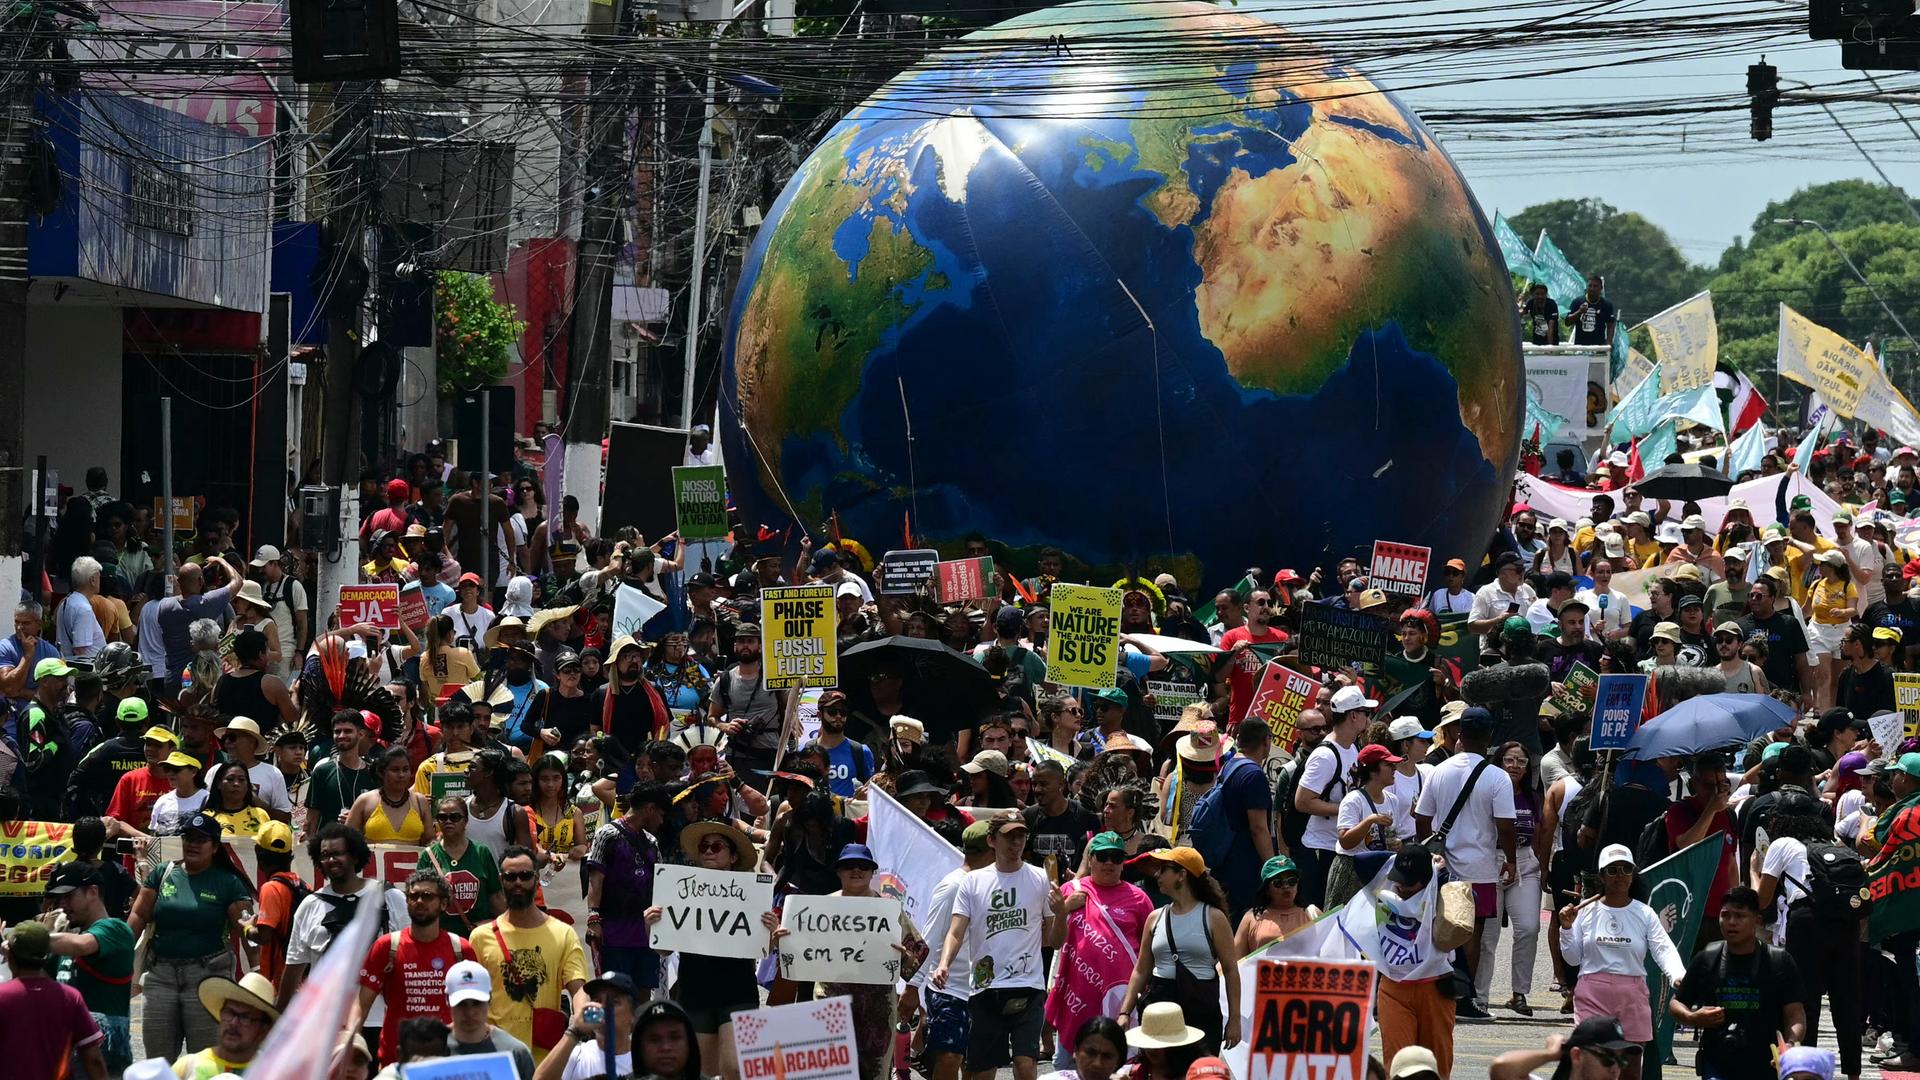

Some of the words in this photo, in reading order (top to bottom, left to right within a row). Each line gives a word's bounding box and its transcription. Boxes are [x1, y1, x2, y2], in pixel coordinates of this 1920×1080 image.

[683, 480, 716, 492] NOSSO
[681, 491, 720, 503] FUTURO
[690, 513, 724, 525] VENDA
[1373, 555, 1425, 583] MAKE
[764, 589, 782, 599] FAST
[783, 589, 799, 598] AND
[800, 587, 833, 597] FOREVER
[1371, 577, 1422, 596] POLLUTERS
[774, 600, 824, 620] PHASE
[1069, 605, 1083, 614] WE
[1084, 608, 1103, 616] ARE
[784, 619, 815, 638] OUT
[1052, 611, 1119, 637] NATURE
[1056, 630, 1072, 641] THE
[1073, 634, 1112, 644] ANSWER
[773, 637, 827, 658] FOSSIL
[1058, 639, 1077, 663] IS
[1080, 641, 1107, 666] US
[777, 656, 825, 676] FUELS
[768, 679, 785, 689] FAST
[1148, 681, 1162, 690] COP
[1163, 683, 1173, 692] DA
[1285, 674, 1312, 697] END
[1281, 688, 1307, 711] THE
[1152, 705, 1183, 716] OMOS
[1264, 699, 1299, 727] FOSS
[1602, 709, 1630, 722] POVOS
[1600, 722, 1614, 737] DE
[111, 758, 147, 770] TRÂNSIT
[1, 820, 69, 841] VIV
[454, 882, 478, 893] VENDA
[678, 874, 748, 902] Floresta
[991, 887, 1017, 910] EU
[667, 905, 752, 936] VIVA
[792, 906, 891, 934] FLORESTA
[803, 946, 833, 963] EM
[840, 940, 867, 963] PÉ
[403, 962, 417, 970] POR
[404, 970, 444, 979] TRANSIÇÃO
[404, 978, 447, 987] ENERGÉTICA
[405, 986, 443, 995] ECOLÓGICA
[1254, 998, 1361, 1055] AGRO
